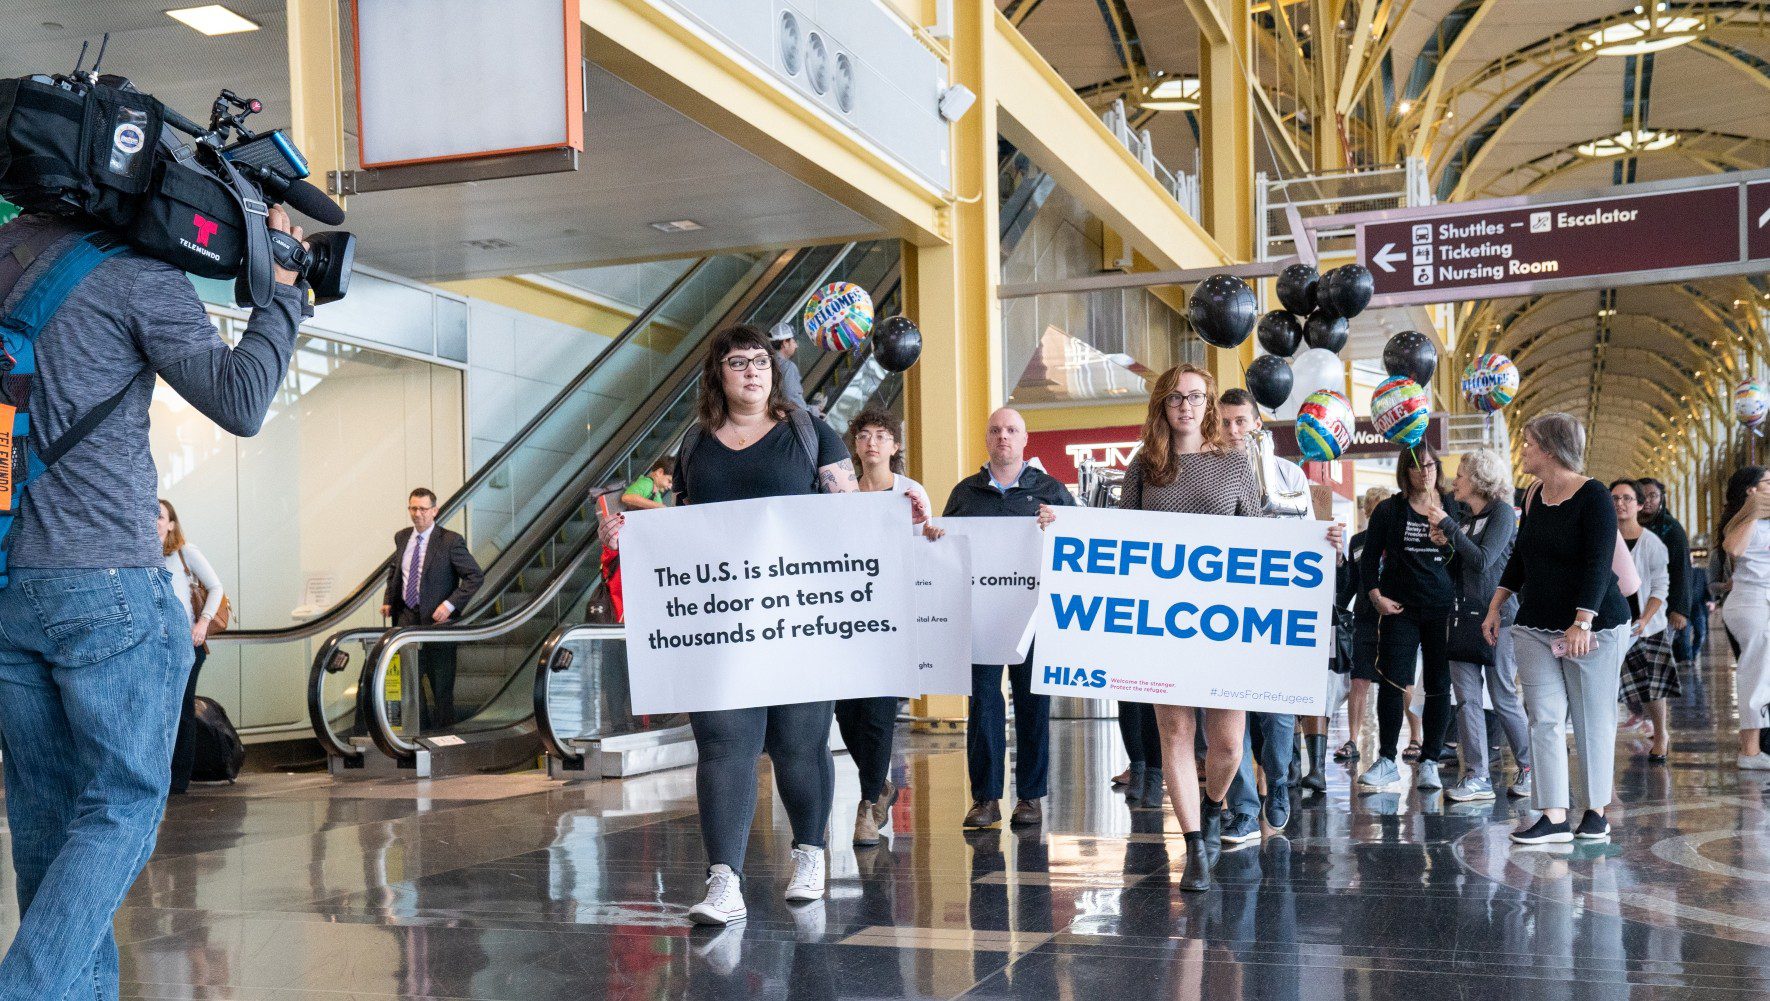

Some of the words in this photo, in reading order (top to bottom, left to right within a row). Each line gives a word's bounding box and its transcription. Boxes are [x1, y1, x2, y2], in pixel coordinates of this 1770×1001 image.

[1439, 219, 1505, 240] Shuttles
[1557, 207, 1639, 228] Escalator
[179, 237, 220, 261] TELEMUNDO
[272, 236, 291, 250] Canon
[1439, 241, 1513, 261] Ticketing
[1439, 263, 1504, 282] Nursing
[1509, 259, 1559, 276] Room
[653, 566, 691, 587] The
[696, 561, 737, 583] U.S.
[744, 560, 762, 580] is
[768, 553, 880, 577] slamming
[1052, 535, 1324, 588] REFUGEES
[979, 571, 1040, 591] coming.
[666, 596, 698, 618] the
[704, 593, 754, 614] door
[761, 594, 790, 610] on
[796, 589, 844, 606] tens
[850, 582, 873, 602] of
[930, 615, 948, 623] Area
[1050, 592, 1318, 648] WELCOME
[648, 622, 756, 650] thousands
[762, 618, 785, 640] of
[791, 615, 898, 640] refugees.
[1043, 665, 1107, 688] HIAS
[1110, 677, 1138, 685] Welcome
[1110, 683, 1131, 691] Protect
[1143, 686, 1168, 694] refugee.
[1210, 687, 1315, 705] #JewsForRefugees
